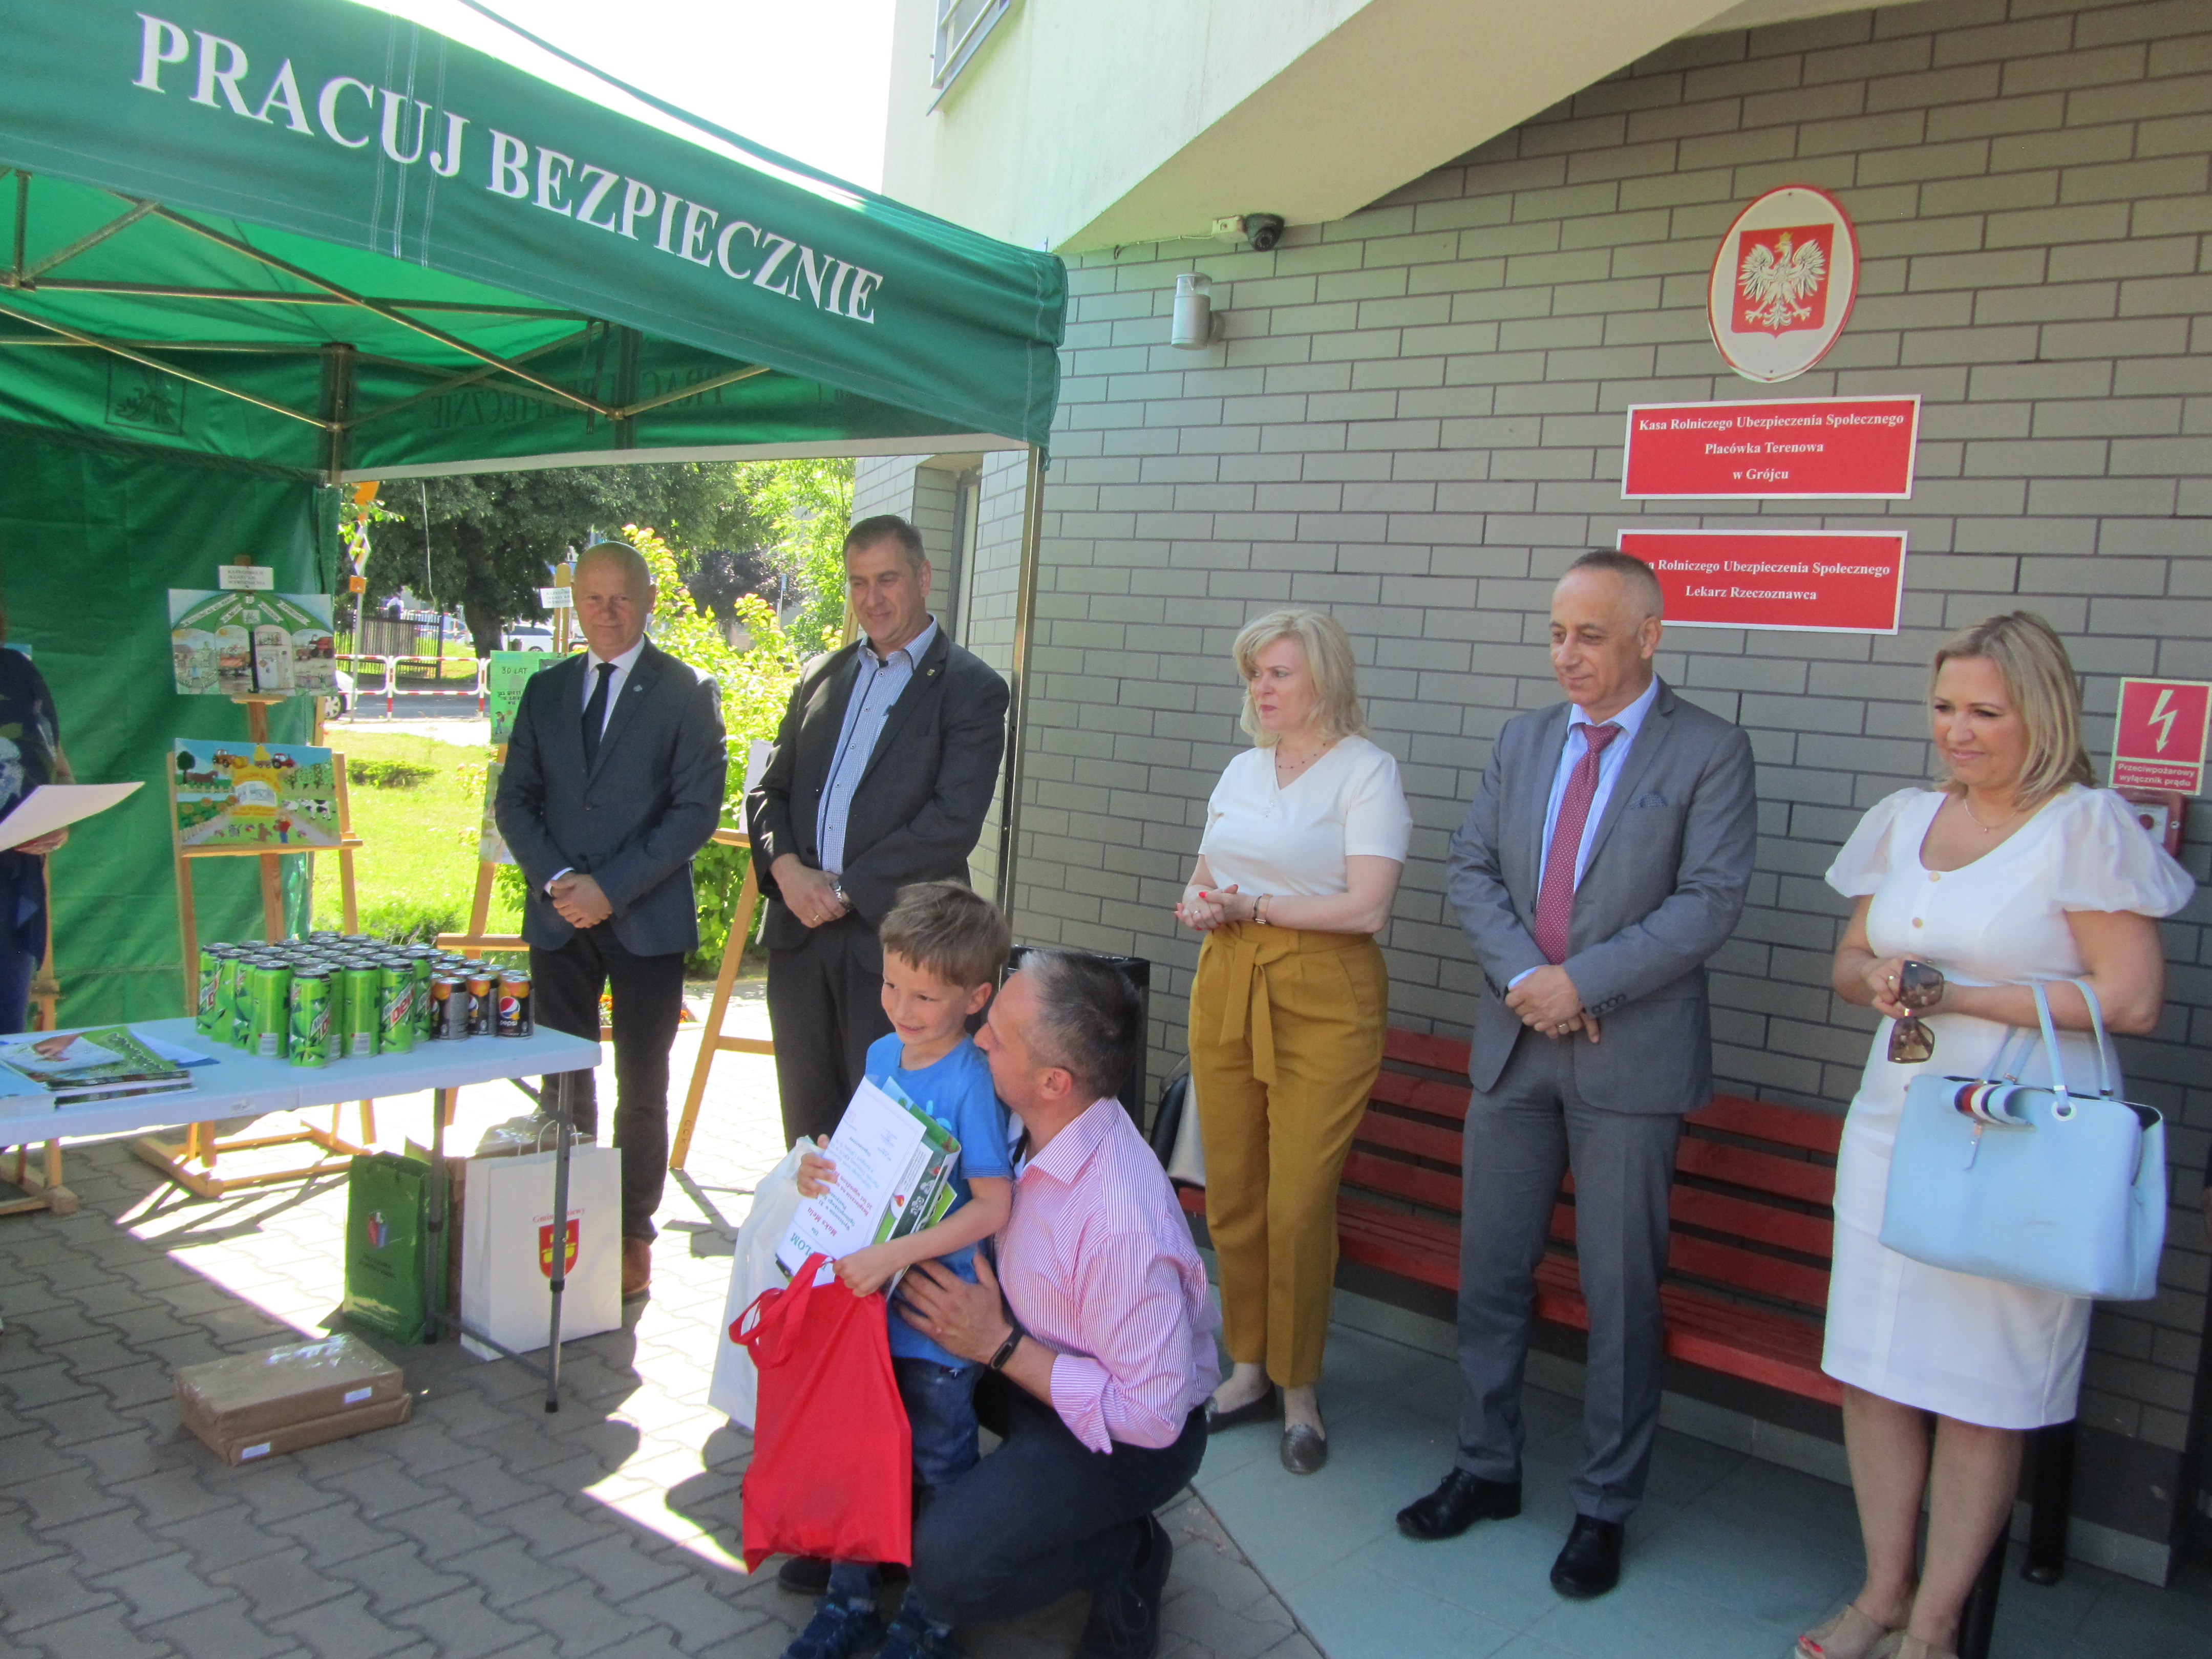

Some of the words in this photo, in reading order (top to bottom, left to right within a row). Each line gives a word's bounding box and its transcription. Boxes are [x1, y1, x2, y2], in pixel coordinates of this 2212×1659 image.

[132, 12, 470, 177] PRACUJ
[484, 128, 883, 324] BEZPIECZNIE
[1639, 419, 1667, 431] Kasa
[1670, 417, 1733, 431] Rolniczego
[1736, 414, 1822, 430] Ubezpieczenia
[1826, 413, 1904, 428] Społecznego
[1705, 442, 1761, 455] Placówka
[1764, 441, 1824, 454] Terenowa
[1732, 472, 1743, 480] w
[1746, 467, 1789, 482] Grójcu
[1658, 559, 1720, 574] Rolniczego
[1724, 561, 1809, 575] Ubezpieczenia
[1812, 562, 1890, 578] Społecznego
[1685, 585, 1727, 598] Lekarz
[1730, 587, 1817, 600] Rzeczoznawca
[2118, 763, 2195, 778] Przeciwpożarowy
[2120, 775, 2162, 783] wyłącznik
[2164, 778, 2190, 786] prądu
[845, 1192, 868, 1216] Bezpiecznie
[533, 1214, 555, 1223] Gmin
[807, 1207, 821, 1222] Mela
[811, 1227, 819, 1236] Dla
[821, 1219, 837, 1237] Maks
